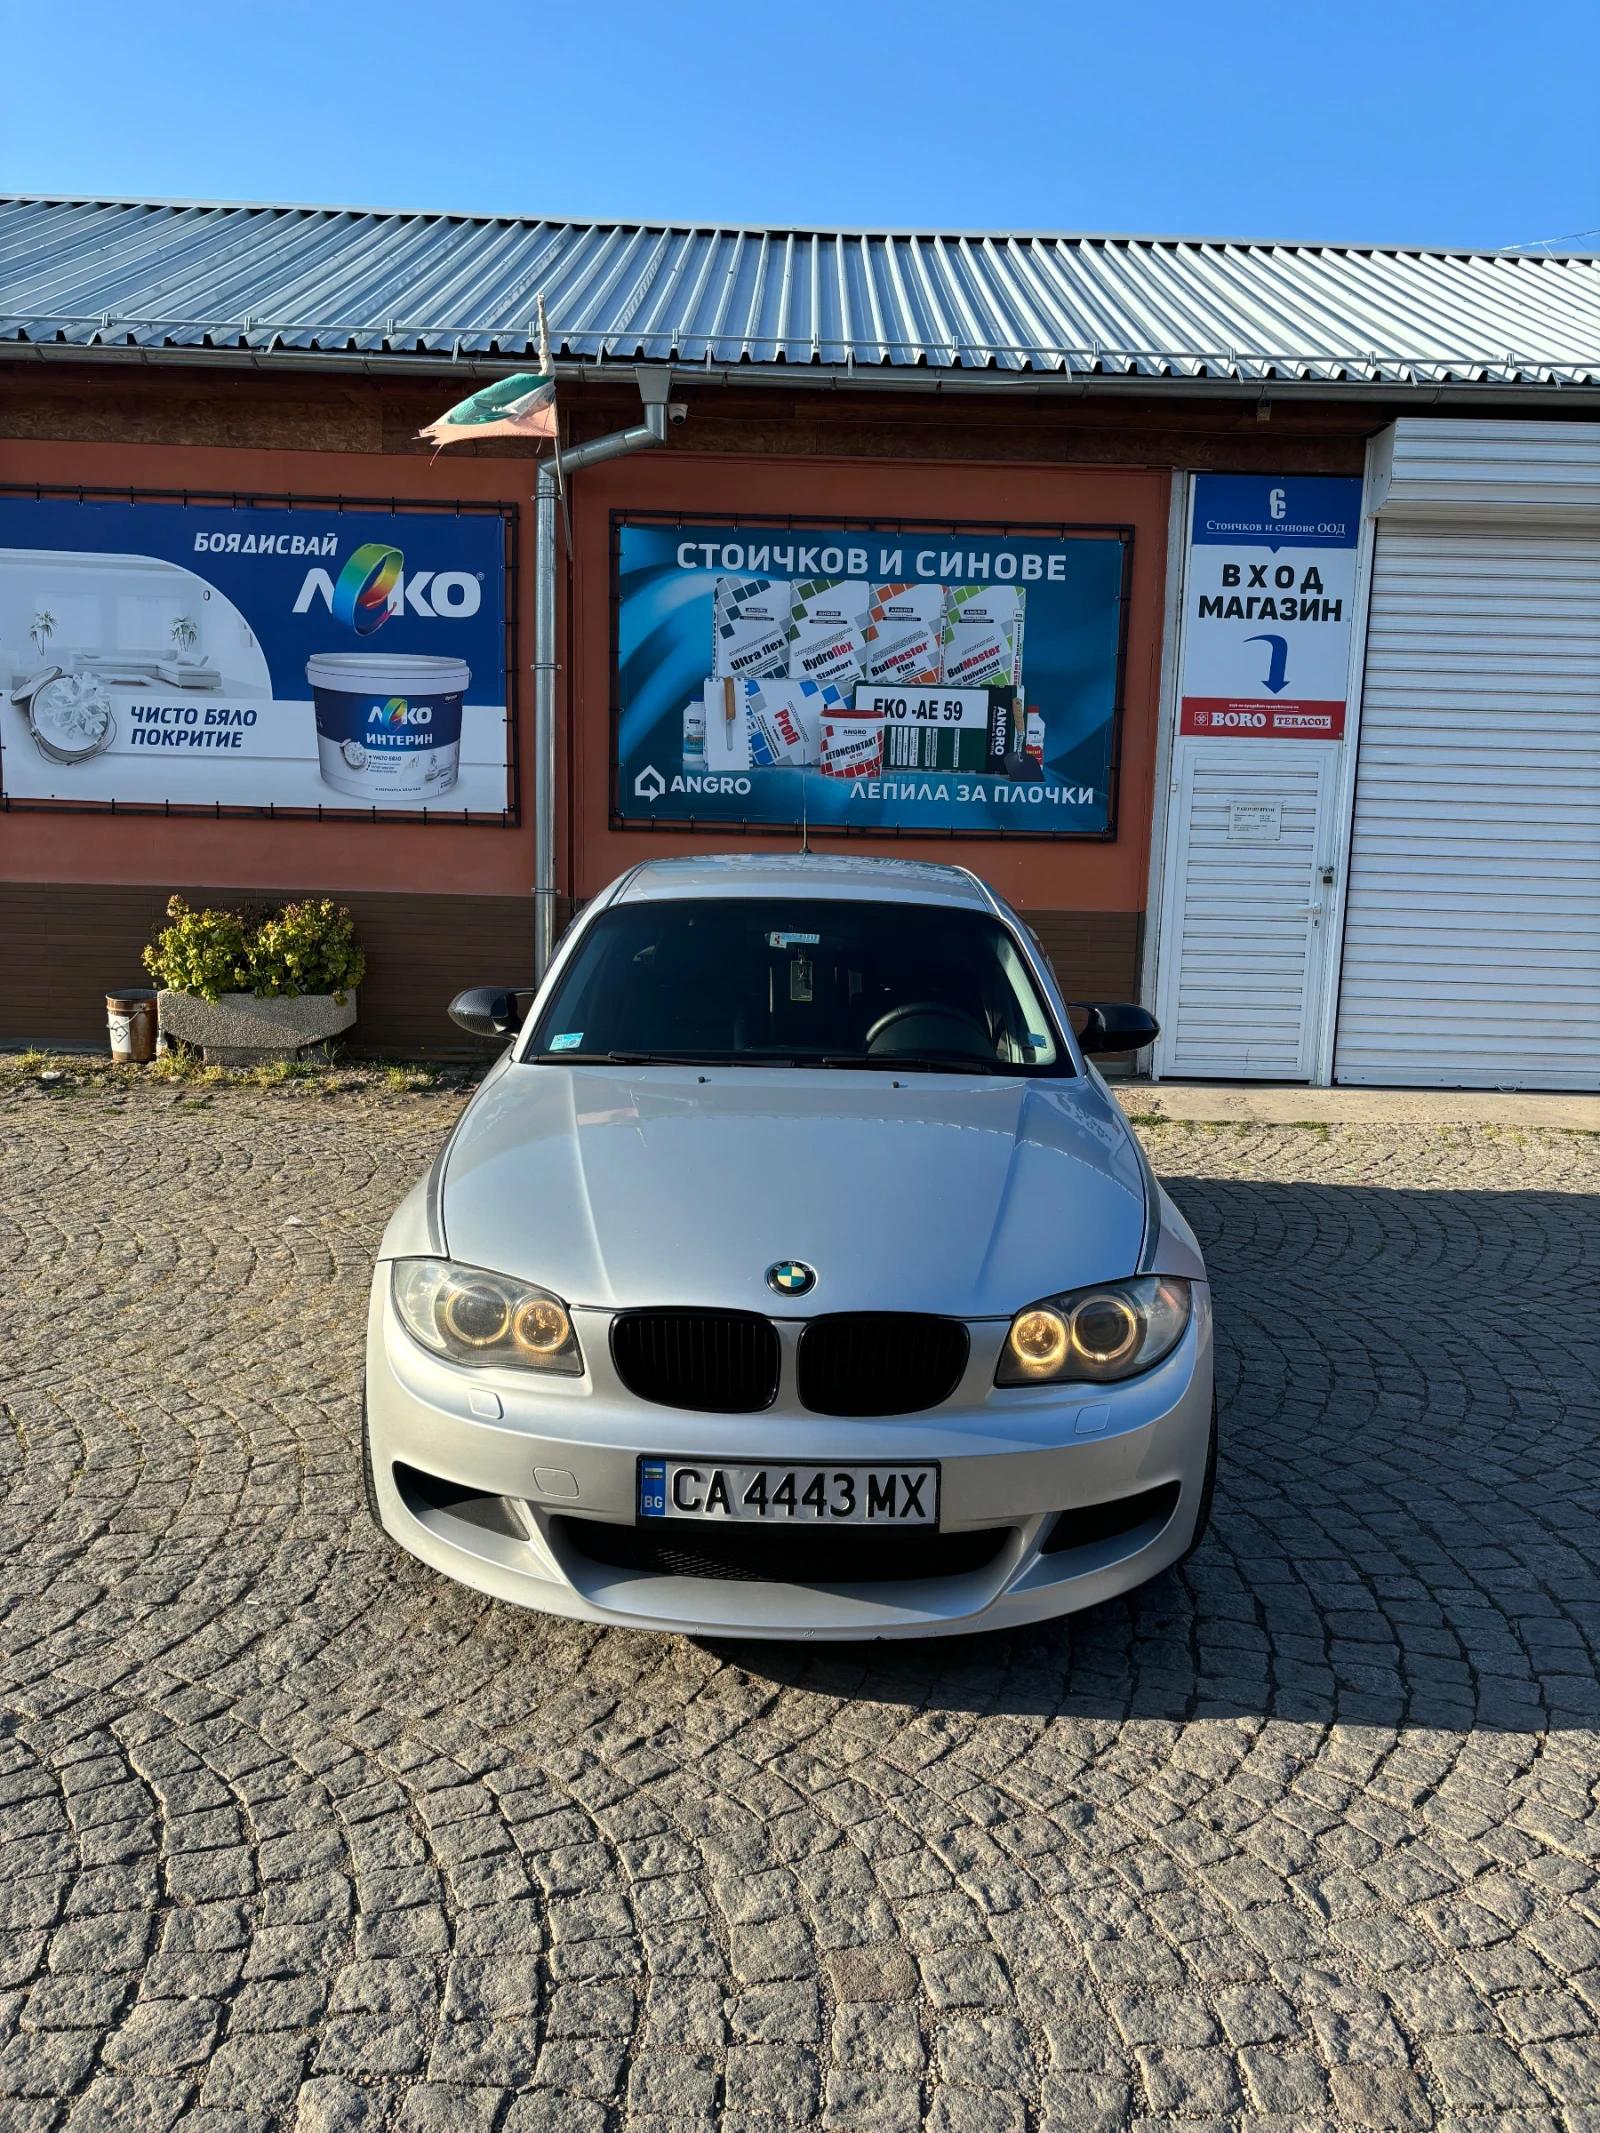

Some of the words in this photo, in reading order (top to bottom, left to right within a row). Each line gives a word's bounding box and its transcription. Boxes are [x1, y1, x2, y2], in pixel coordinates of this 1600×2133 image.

[1206, 520, 1262, 533] Стоичков
[1265, 524, 1272, 532] и
[1276, 525, 1315, 534] синове
[1317, 523, 1346, 536] ООД
[193, 532, 338, 556] БОЯДИСВАЙ
[677, 542, 868, 574] СТОИЧКОВ
[879, 549, 902, 575] И
[915, 550, 1067, 581] СИНОВЕ
[1222, 564, 1324, 595] ВХОД
[1198, 595, 1343, 622] МАГАЗИН
[730, 651, 762, 671] Ultra
[762, 638, 785, 656] flex
[801, 641, 854, 671] Hydroflex
[870, 642, 928, 677] BulMaster
[947, 645, 1001, 679] BulMaster
[816, 660, 853, 680] Standart
[896, 660, 916, 674] Flex
[962, 659, 1000, 683] Universal
[131, 706, 198, 725] ЧИСТО
[204, 708, 257, 726] БЯЛО
[873, 698, 907, 719] EKO
[943, 701, 963, 721] 59
[1211, 712, 1267, 727] BORO
[131, 728, 243, 748] ПОКРИТИЕ
[366, 732, 433, 745] ИНТЕРИН
[774, 708, 801, 746] Profi
[995, 706, 1007, 755] ANGRO
[825, 736, 876, 761] BETONCONTAKT
[670, 775, 751, 795] ANGRO
[850, 782, 950, 801] ЛЕПИЛА
[956, 785, 987, 802] ЗА
[994, 786, 1094, 804] ПЛОЧКИ
[643, 1494, 663, 1509] BG
[671, 1467, 731, 1515] CA
[742, 1471, 856, 1517] 4443
[867, 1473, 928, 1518] MX
